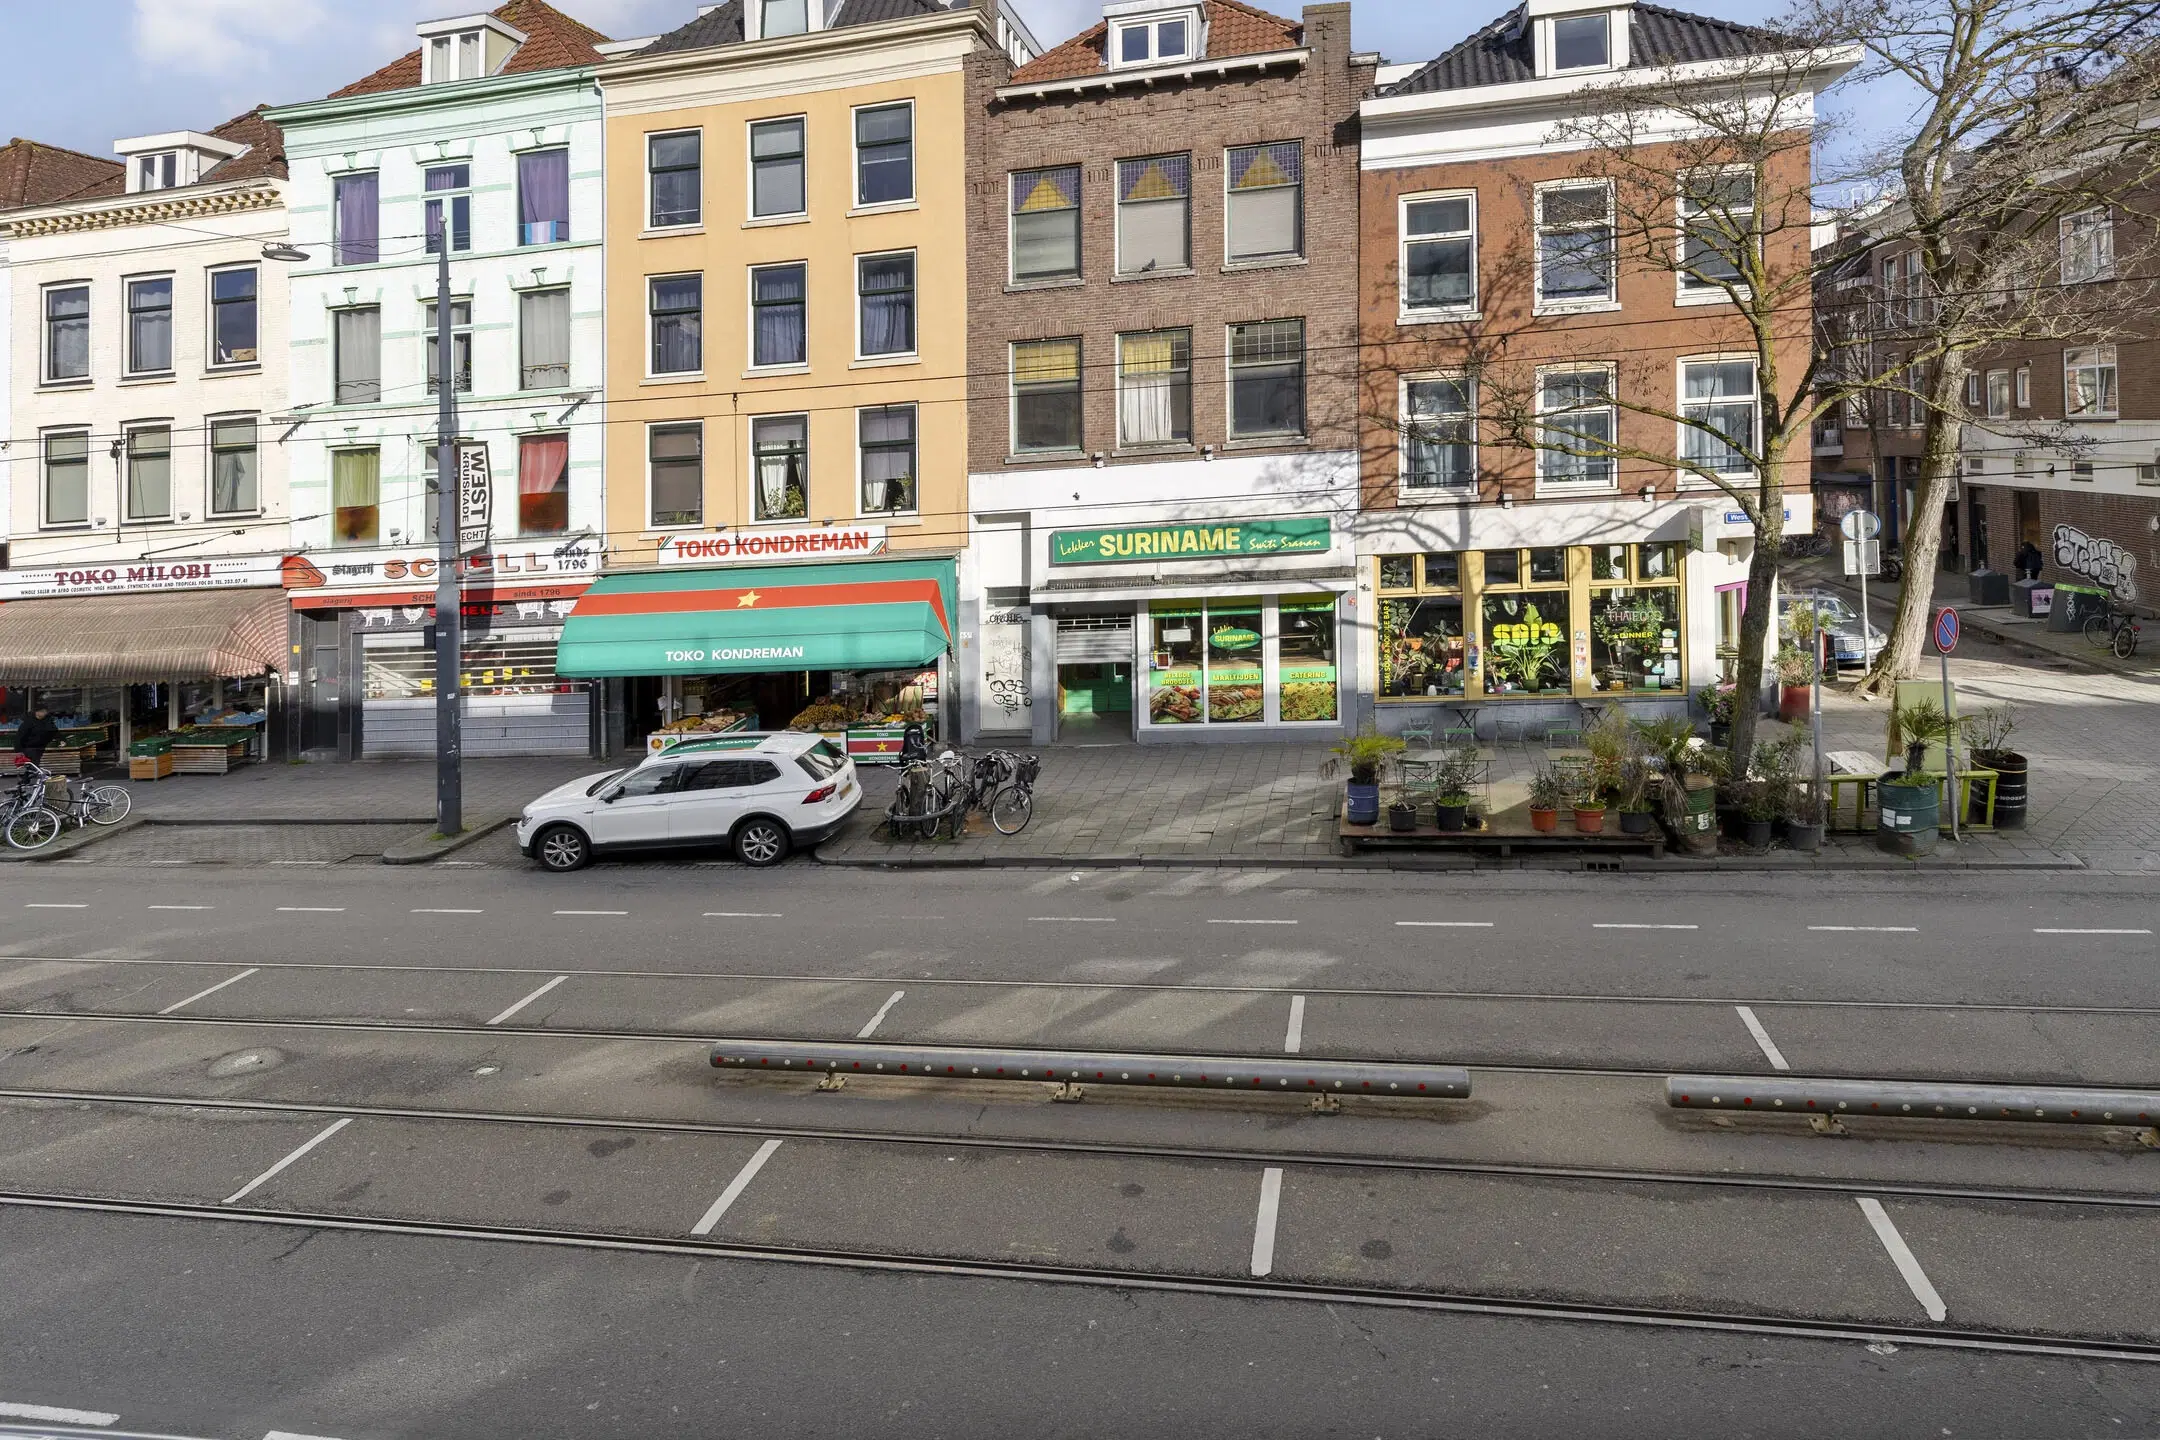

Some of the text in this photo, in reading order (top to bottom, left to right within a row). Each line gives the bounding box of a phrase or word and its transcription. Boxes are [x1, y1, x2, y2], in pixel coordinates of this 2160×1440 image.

[462, 451, 471, 523] KRUISKADE
[461, 530, 486, 541] ECHT
[1099, 527, 1241, 557] SURINAME
[674, 531, 869, 559] TOKO KONDREMAN
[558, 559, 588, 570] 1796
[54, 563, 212, 586] TOKO MILOBI
[512, 590, 537, 598] sinds
[1383, 605, 1391, 620] BAR
[1619, 631, 1654, 639] DINNER
[665, 646, 804, 662] TOKO KONDREMAN
